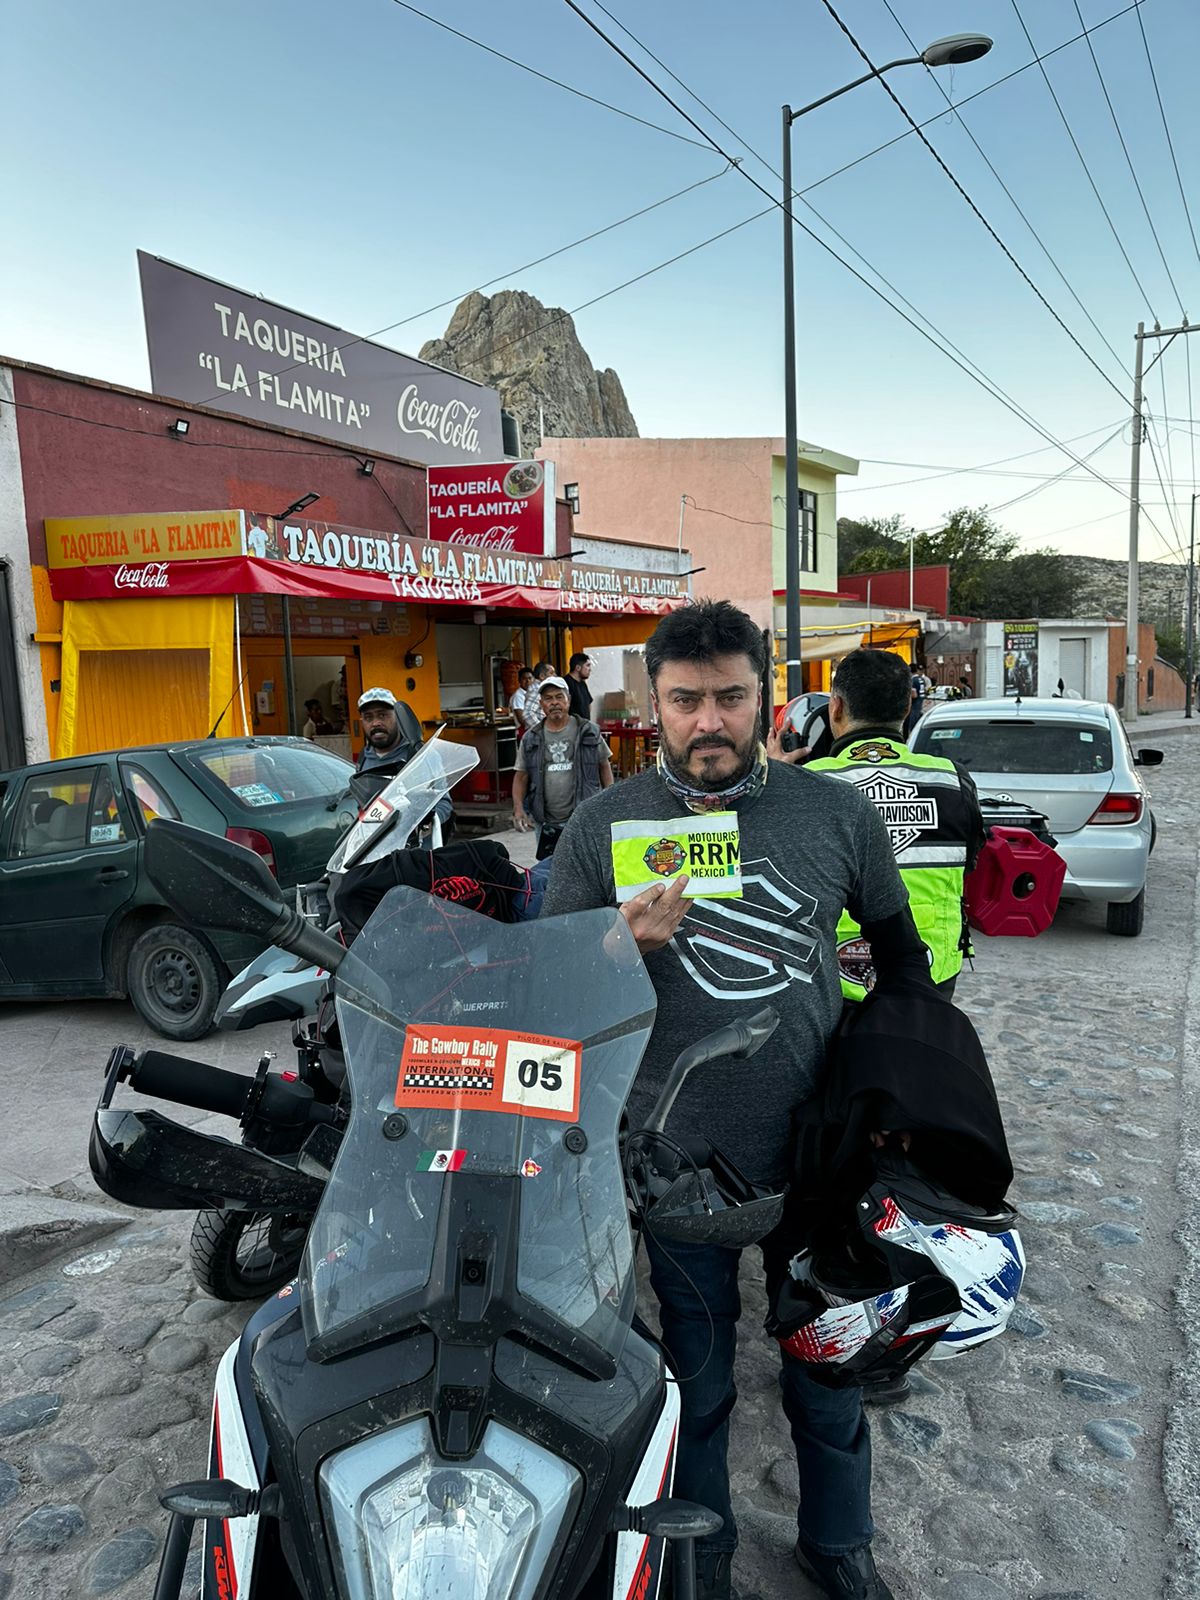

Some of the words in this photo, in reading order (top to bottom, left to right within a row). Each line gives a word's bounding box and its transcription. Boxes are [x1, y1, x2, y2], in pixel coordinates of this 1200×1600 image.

[214, 302, 347, 377] TAQUERIA
[430, 477, 502, 497] TAQUERÍA
[60, 530, 129, 564] TAQUERIA
[282, 525, 419, 574] TAQUERÍA
[387, 573, 482, 601] TAQUERIA
[571, 569, 622, 592] TAQUERÍA
[861, 781, 907, 800] OTOR
[691, 866, 726, 878] MÉXICO
[411, 1037, 429, 1054] The
[431, 1037, 471, 1058] Cowboy
[472, 1039, 499, 1059] Rally
[405, 1065, 495, 1077] INTERNATIONAL
[517, 1058, 563, 1092] 05
